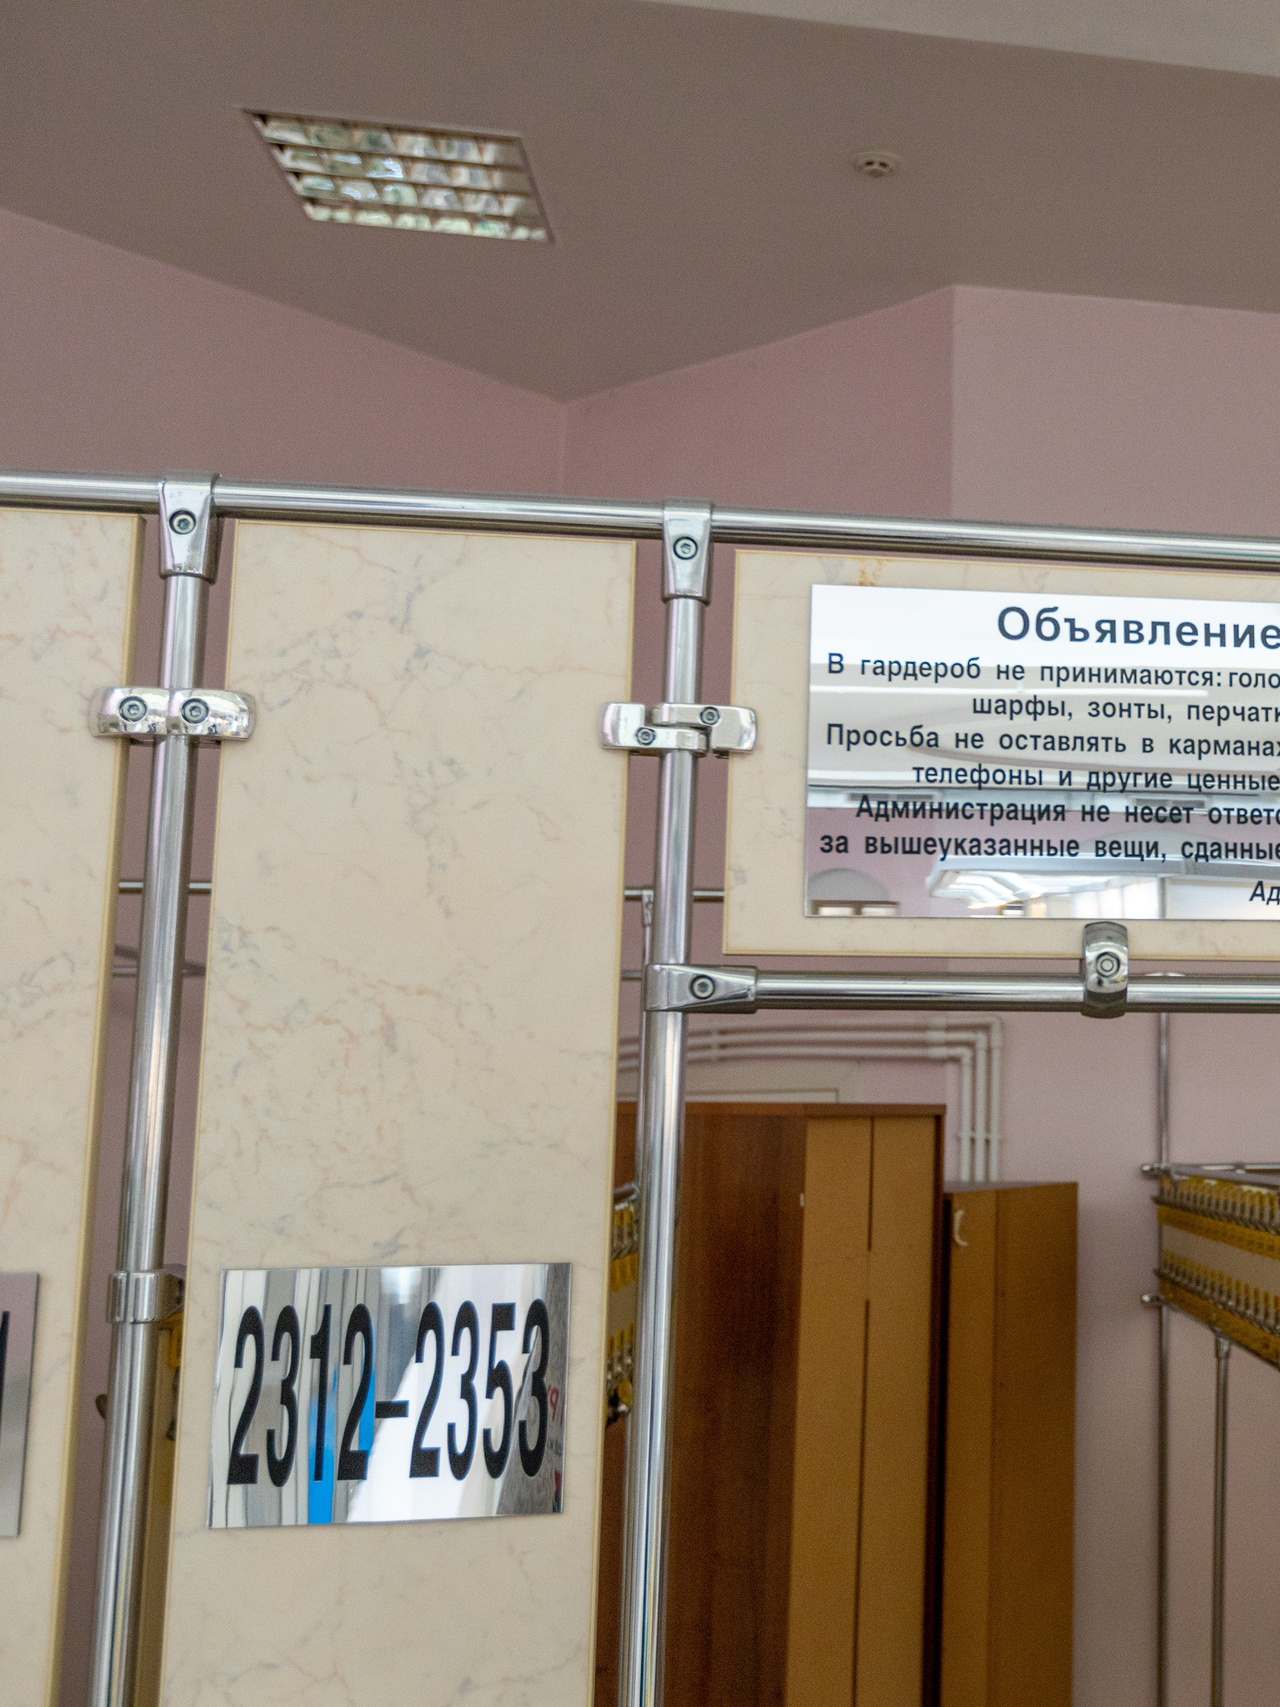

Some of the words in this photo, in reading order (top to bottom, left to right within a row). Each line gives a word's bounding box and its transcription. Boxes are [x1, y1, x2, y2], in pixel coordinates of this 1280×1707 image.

[827, 653, 845, 675] В
[860, 655, 981, 683] гардероб
[996, 663, 1025, 682] не
[1040, 663, 1222, 689] принимаются:
[972, 693, 1074, 722] шарфы,
[1086, 699, 1172, 723] зонты,
[826, 723, 939, 752] Просьба
[955, 731, 984, 751] не
[998, 732, 1127, 754] оставлять
[1141, 735, 1155, 755] в
[912, 761, 1044, 790] телефоны
[1058, 768, 1073, 788] и
[1086, 769, 1172, 794] другие
[855, 798, 1068, 826] Администрация
[1081, 802, 1111, 823] не
[1123, 805, 1195, 825] несет
[819, 834, 849, 855] за
[864, 835, 1079, 862] вышеуказанные
[1094, 838, 1167, 864] вещи,
[227, 1299, 550, 1488] 2312-2353
